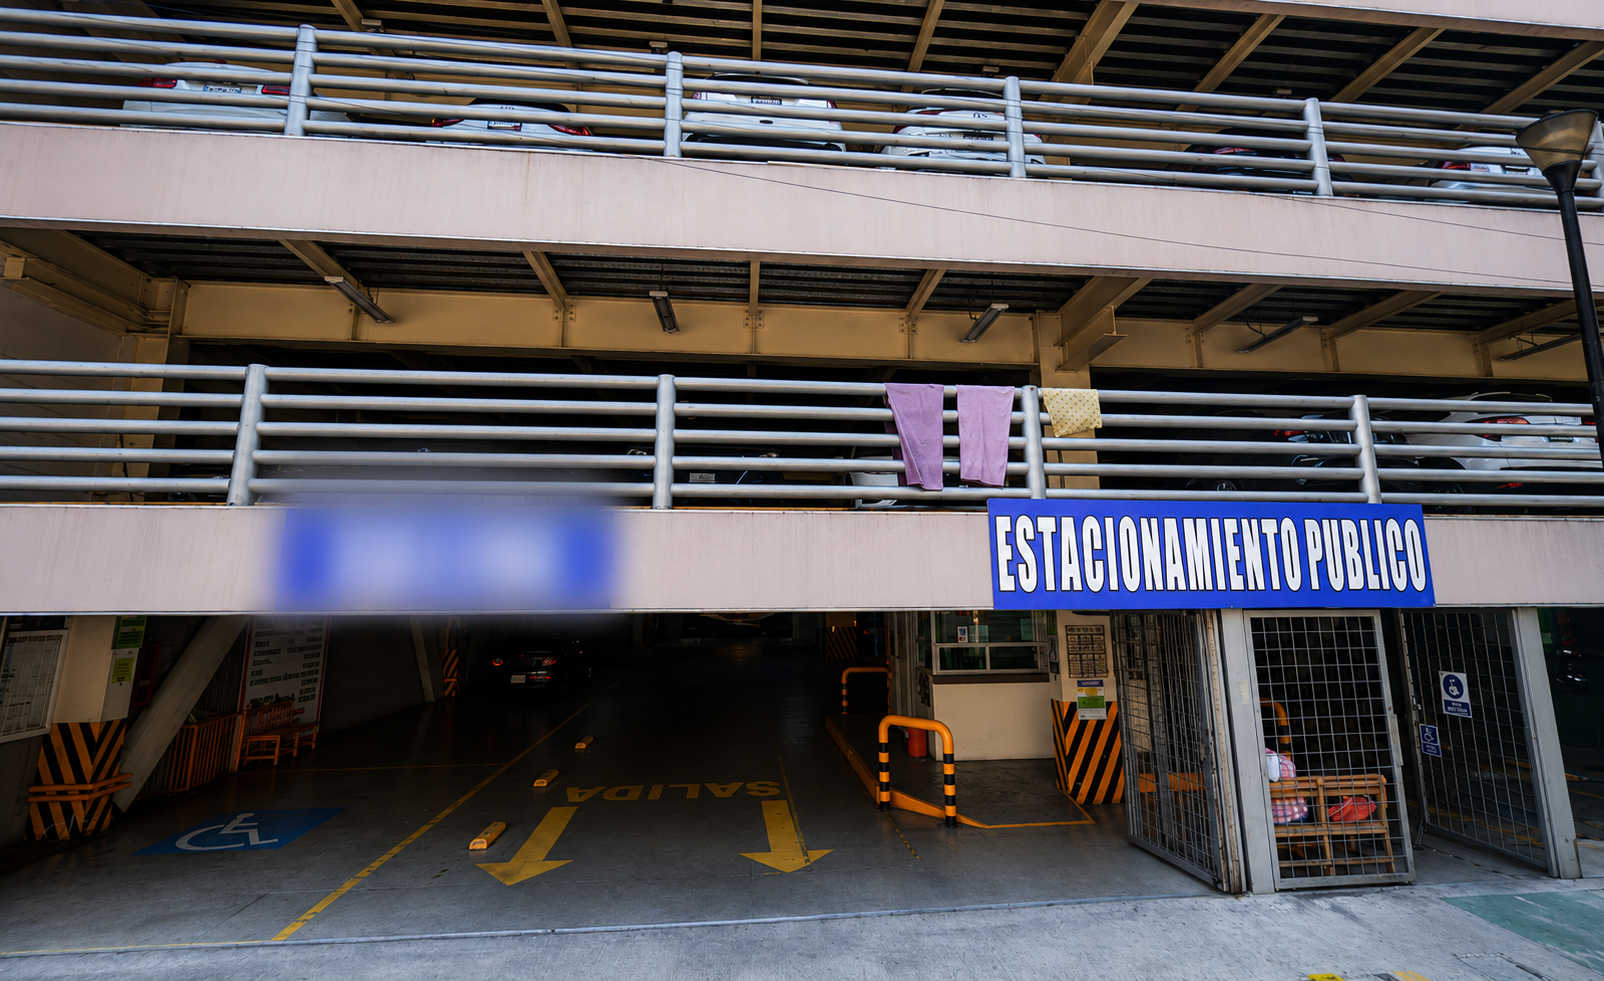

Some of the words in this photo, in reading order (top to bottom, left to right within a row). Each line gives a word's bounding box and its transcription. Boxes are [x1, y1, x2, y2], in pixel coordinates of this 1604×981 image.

[994, 515, 1301, 592] ESTACIONAMIENTO
[1303, 517, 1427, 592] PUBLICO
[566, 781, 781, 802] SALIDA
